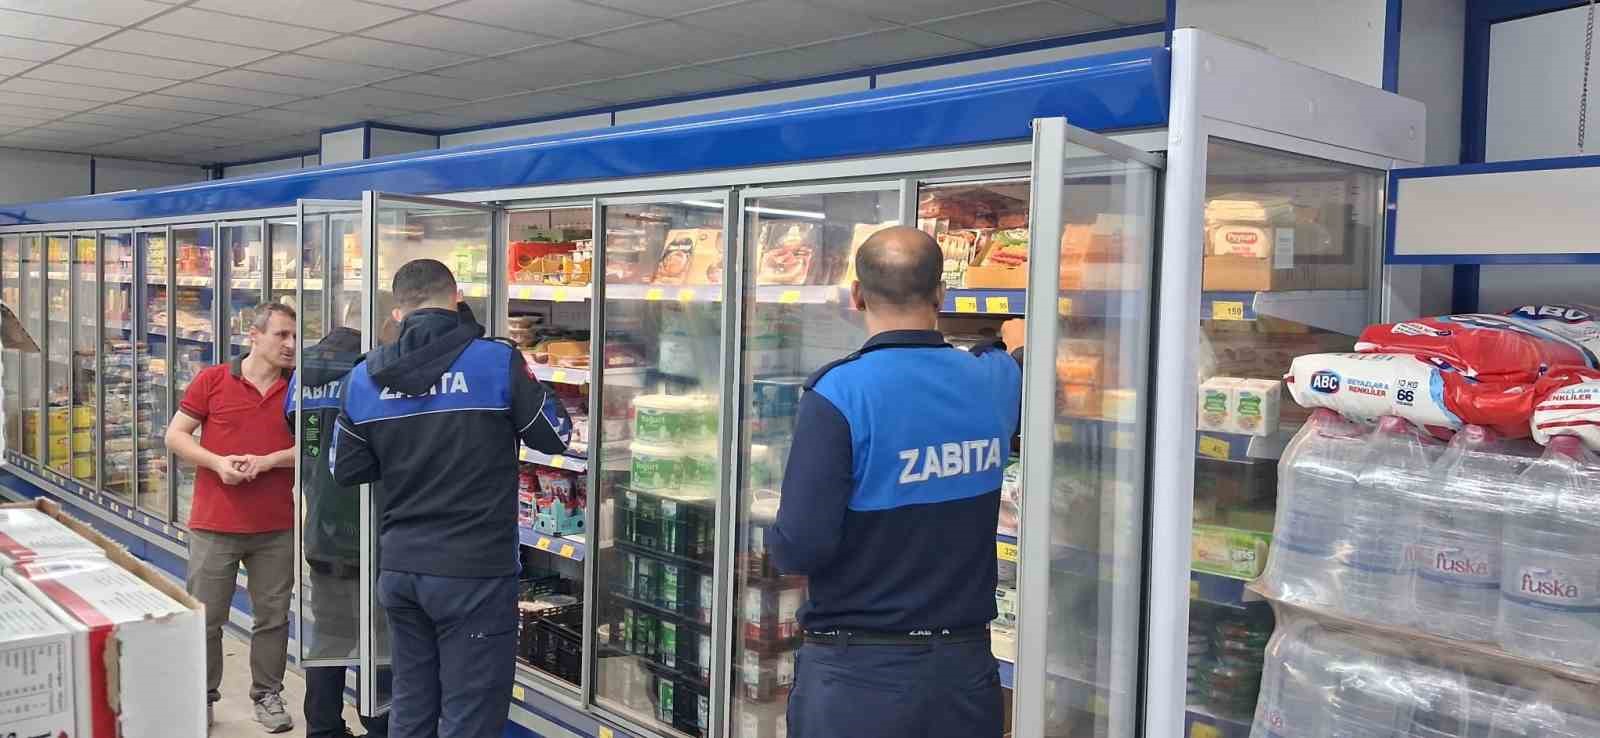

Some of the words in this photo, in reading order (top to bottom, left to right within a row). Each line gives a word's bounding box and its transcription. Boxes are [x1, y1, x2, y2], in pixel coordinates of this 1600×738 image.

[1519, 305, 1589, 320] ABC
[1313, 376, 1337, 390] ABC
[1397, 389, 1414, 402] 66
[899, 437, 1001, 485] ZABITA
[1436, 551, 1488, 576] fuska
[1521, 573, 1578, 598] fuska
